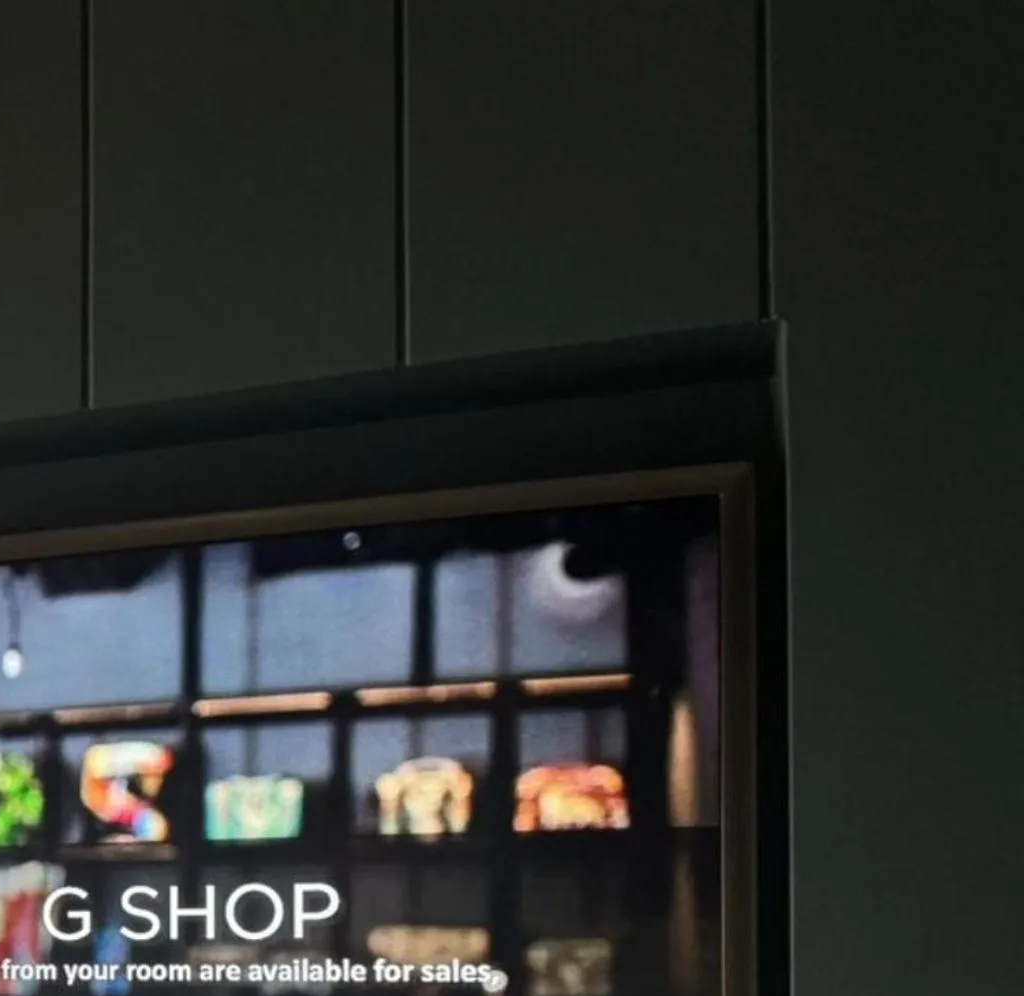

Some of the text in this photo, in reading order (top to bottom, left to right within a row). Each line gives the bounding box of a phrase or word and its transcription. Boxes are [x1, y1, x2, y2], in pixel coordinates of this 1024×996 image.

[42, 882, 340, 942] G SHOP
[2, 958, 57, 982] from
[64, 964, 118, 990] your
[126, 963, 192, 983] room
[199, 965, 242, 983] are
[248, 958, 367, 984] available
[373, 957, 415, 983] for
